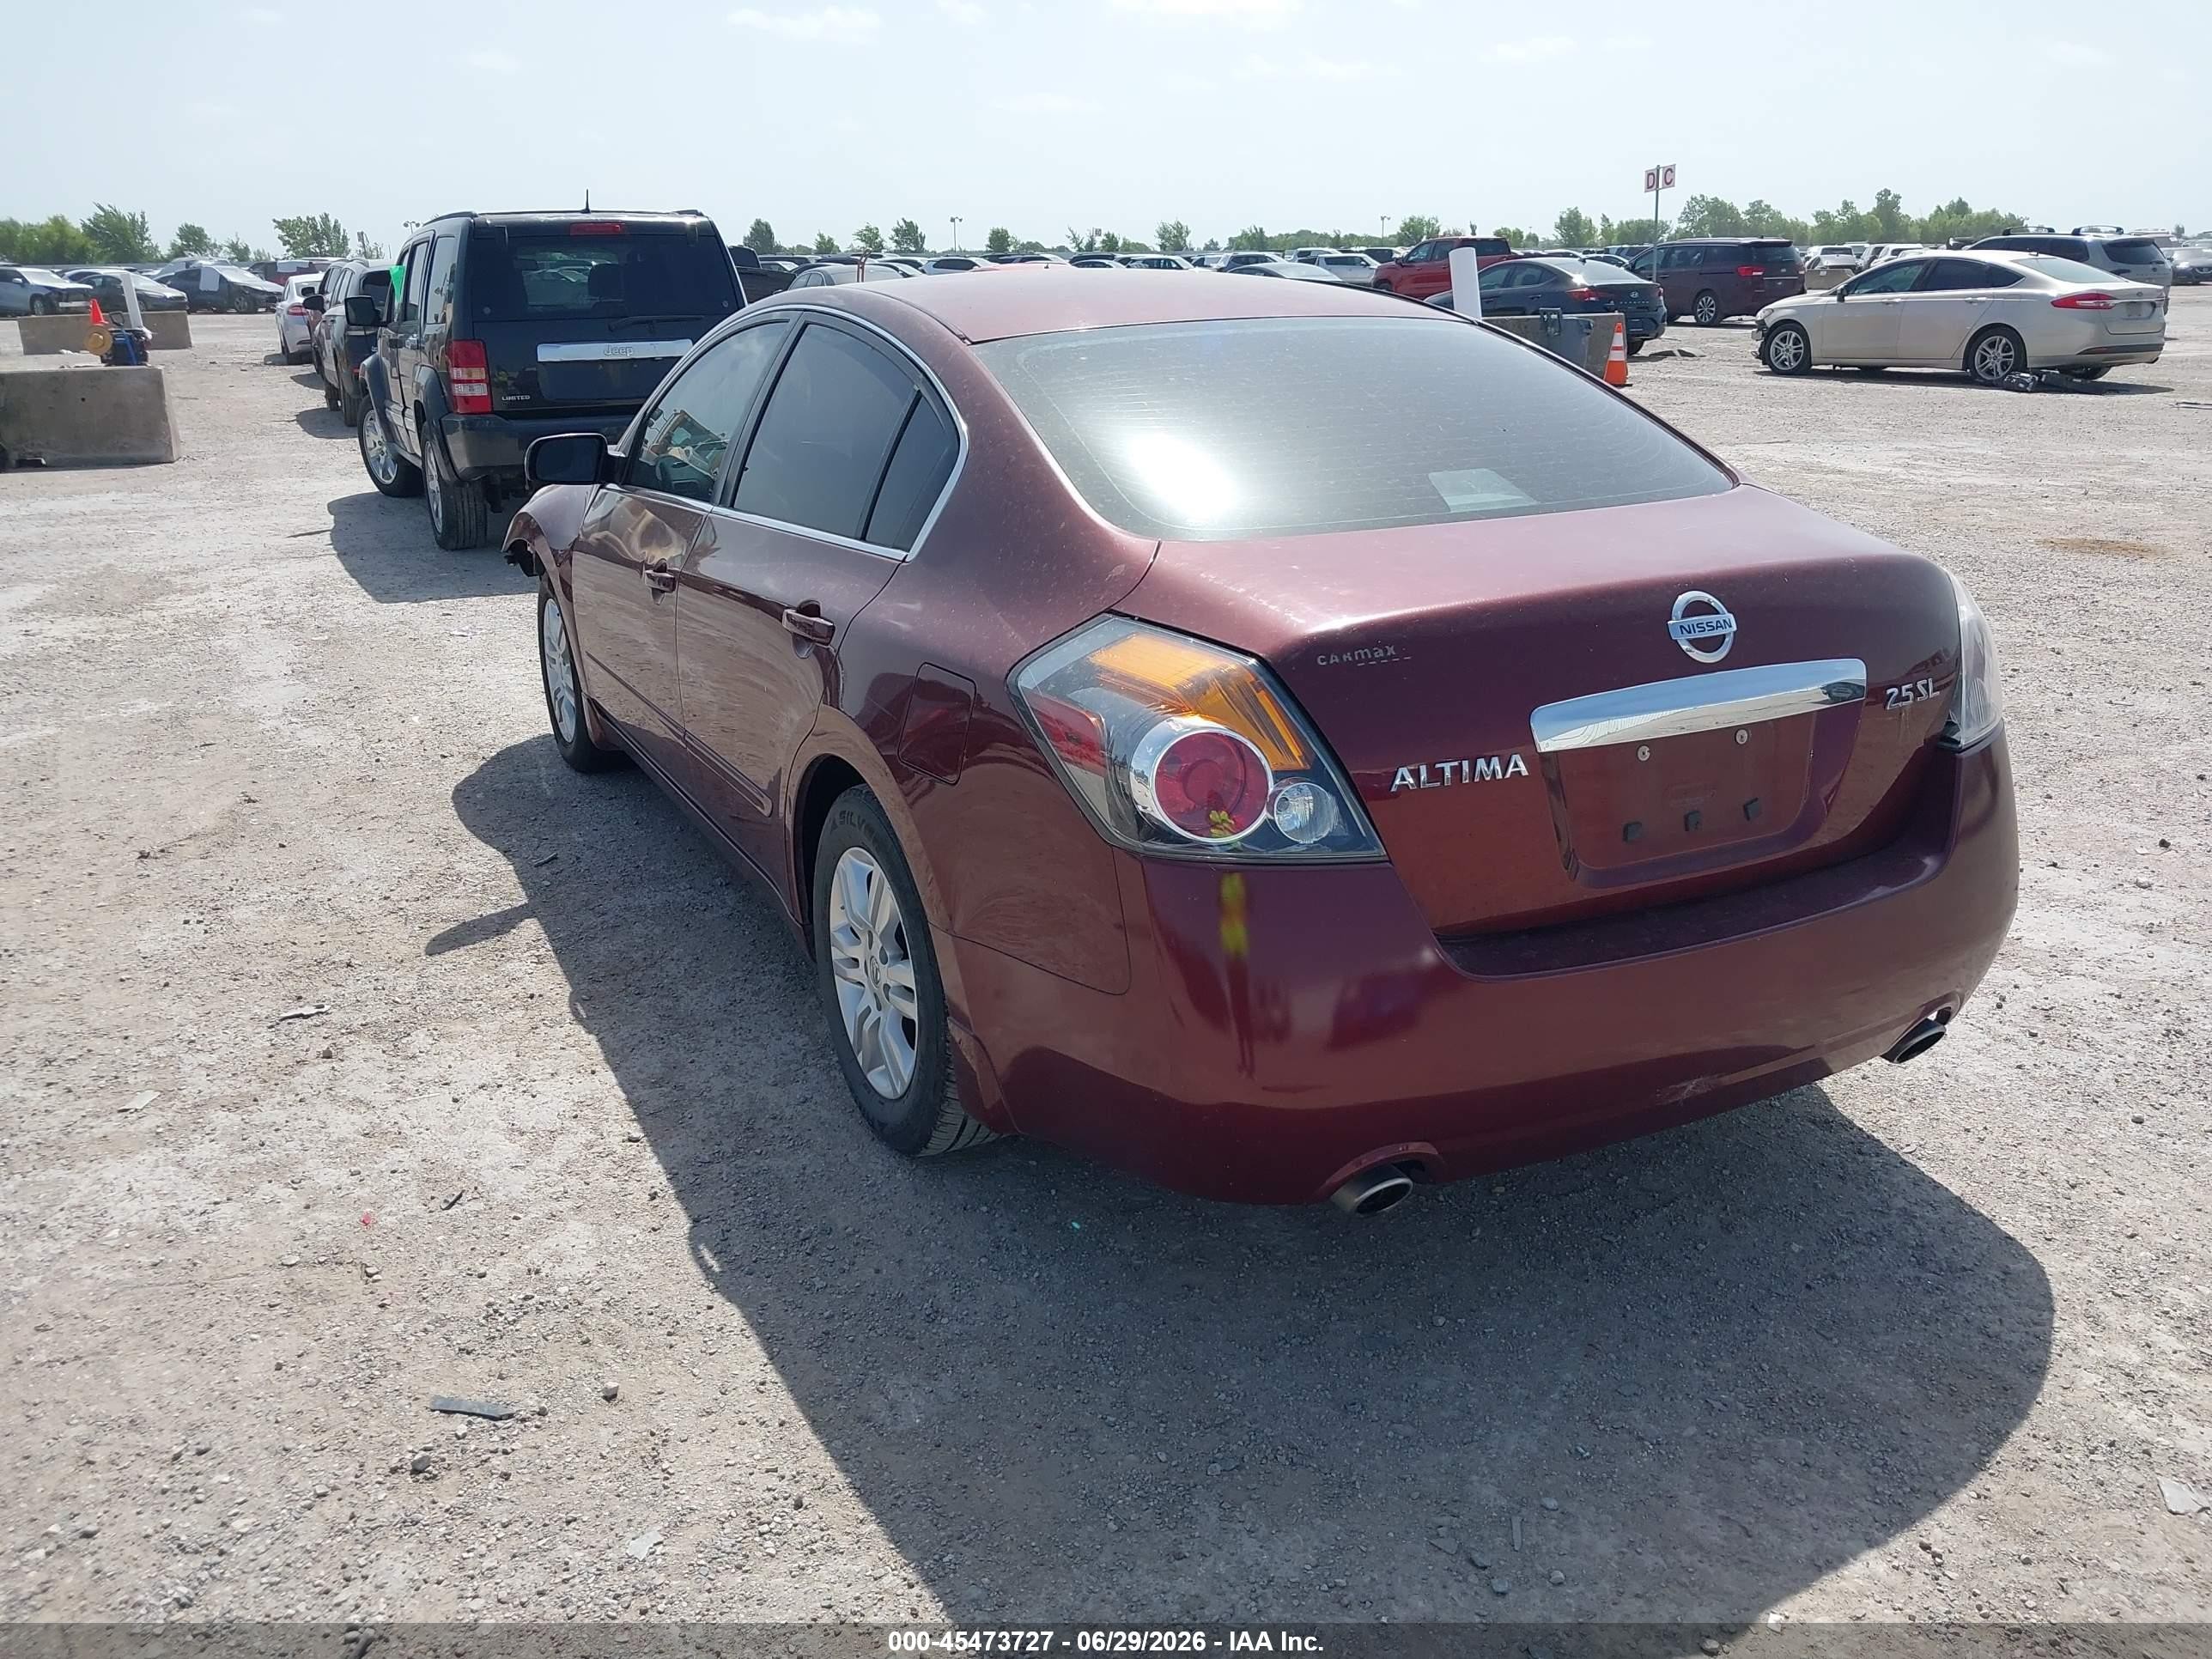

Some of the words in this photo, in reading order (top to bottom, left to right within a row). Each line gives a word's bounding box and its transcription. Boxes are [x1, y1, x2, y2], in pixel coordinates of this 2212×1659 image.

[1646, 172, 1656, 190] D
[1663, 167, 1674, 186] C
[604, 344, 635, 356] Jeep
[1679, 617, 1733, 635] NISSAN
[1916, 678, 1941, 702] SL
[1389, 753, 1529, 793] ALTIMA
